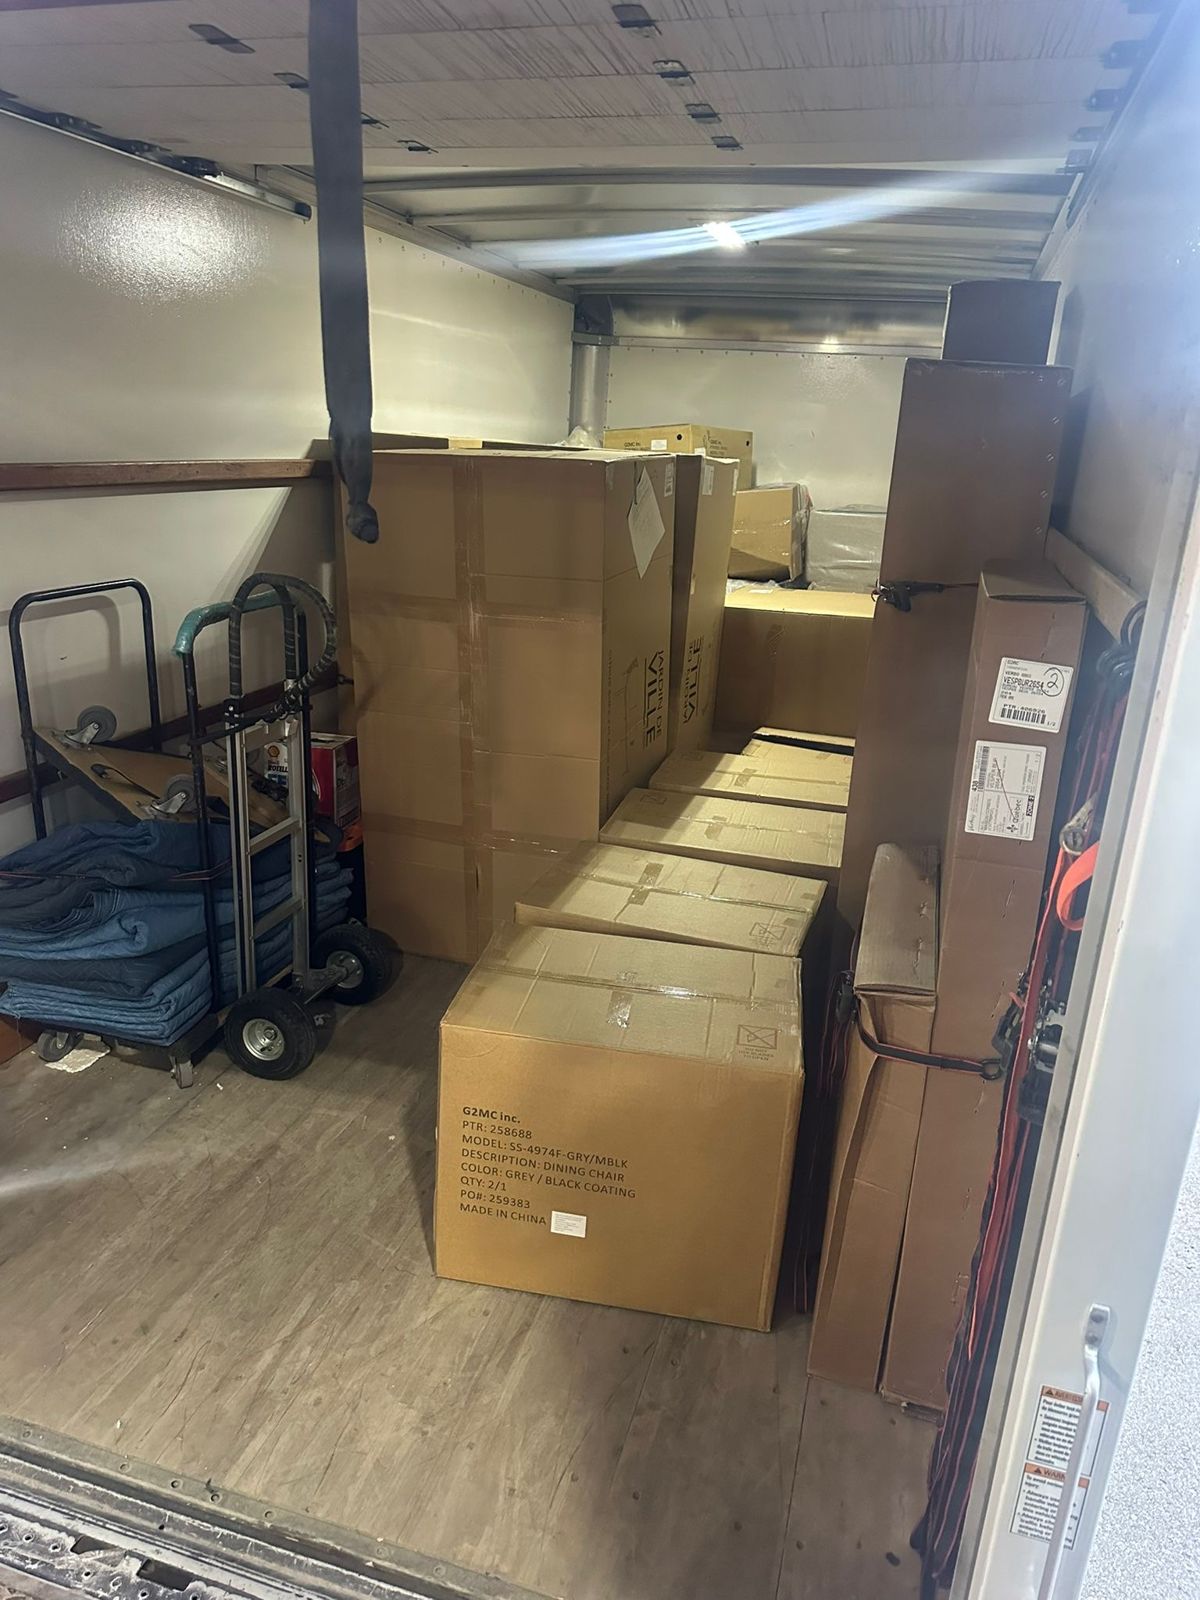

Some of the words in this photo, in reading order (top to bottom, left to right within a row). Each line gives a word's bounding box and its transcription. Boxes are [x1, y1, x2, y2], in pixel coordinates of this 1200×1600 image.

[688, 636, 702, 721] VILLE
[646, 652, 658, 748] VILLE
[462, 1106, 498, 1120] G2MC
[500, 1112, 521, 1124] inc.
[462, 1120, 487, 1133] PTR:
[490, 1124, 533, 1140] 258688
[462, 1134, 507, 1150] MODEL:
[510, 1142, 629, 1169] SS-4974F-GRY/MBLK
[462, 1148, 540, 1169] DESCRIPTION:
[543, 1162, 586, 1177] DINING
[589, 1169, 625, 1182] CHAIR
[460, 1176, 485, 1188] QTY:
[488, 1180, 506, 1192] 2/1
[461, 1162, 502, 1177] COLOR:
[505, 1169, 535, 1182] GREY
[536, 1174, 543, 1184] /
[545, 1176, 581, 1190] BLACK
[584, 1182, 636, 1199] COATING
[460, 1190, 487, 1202] PO#:
[489, 1194, 530, 1209] 259383
[460, 1203, 493, 1216] MADE
[496, 1209, 507, 1219] IN
[510, 1211, 547, 1225] CHINA
[1043, 1469, 1066, 1480] WARN
